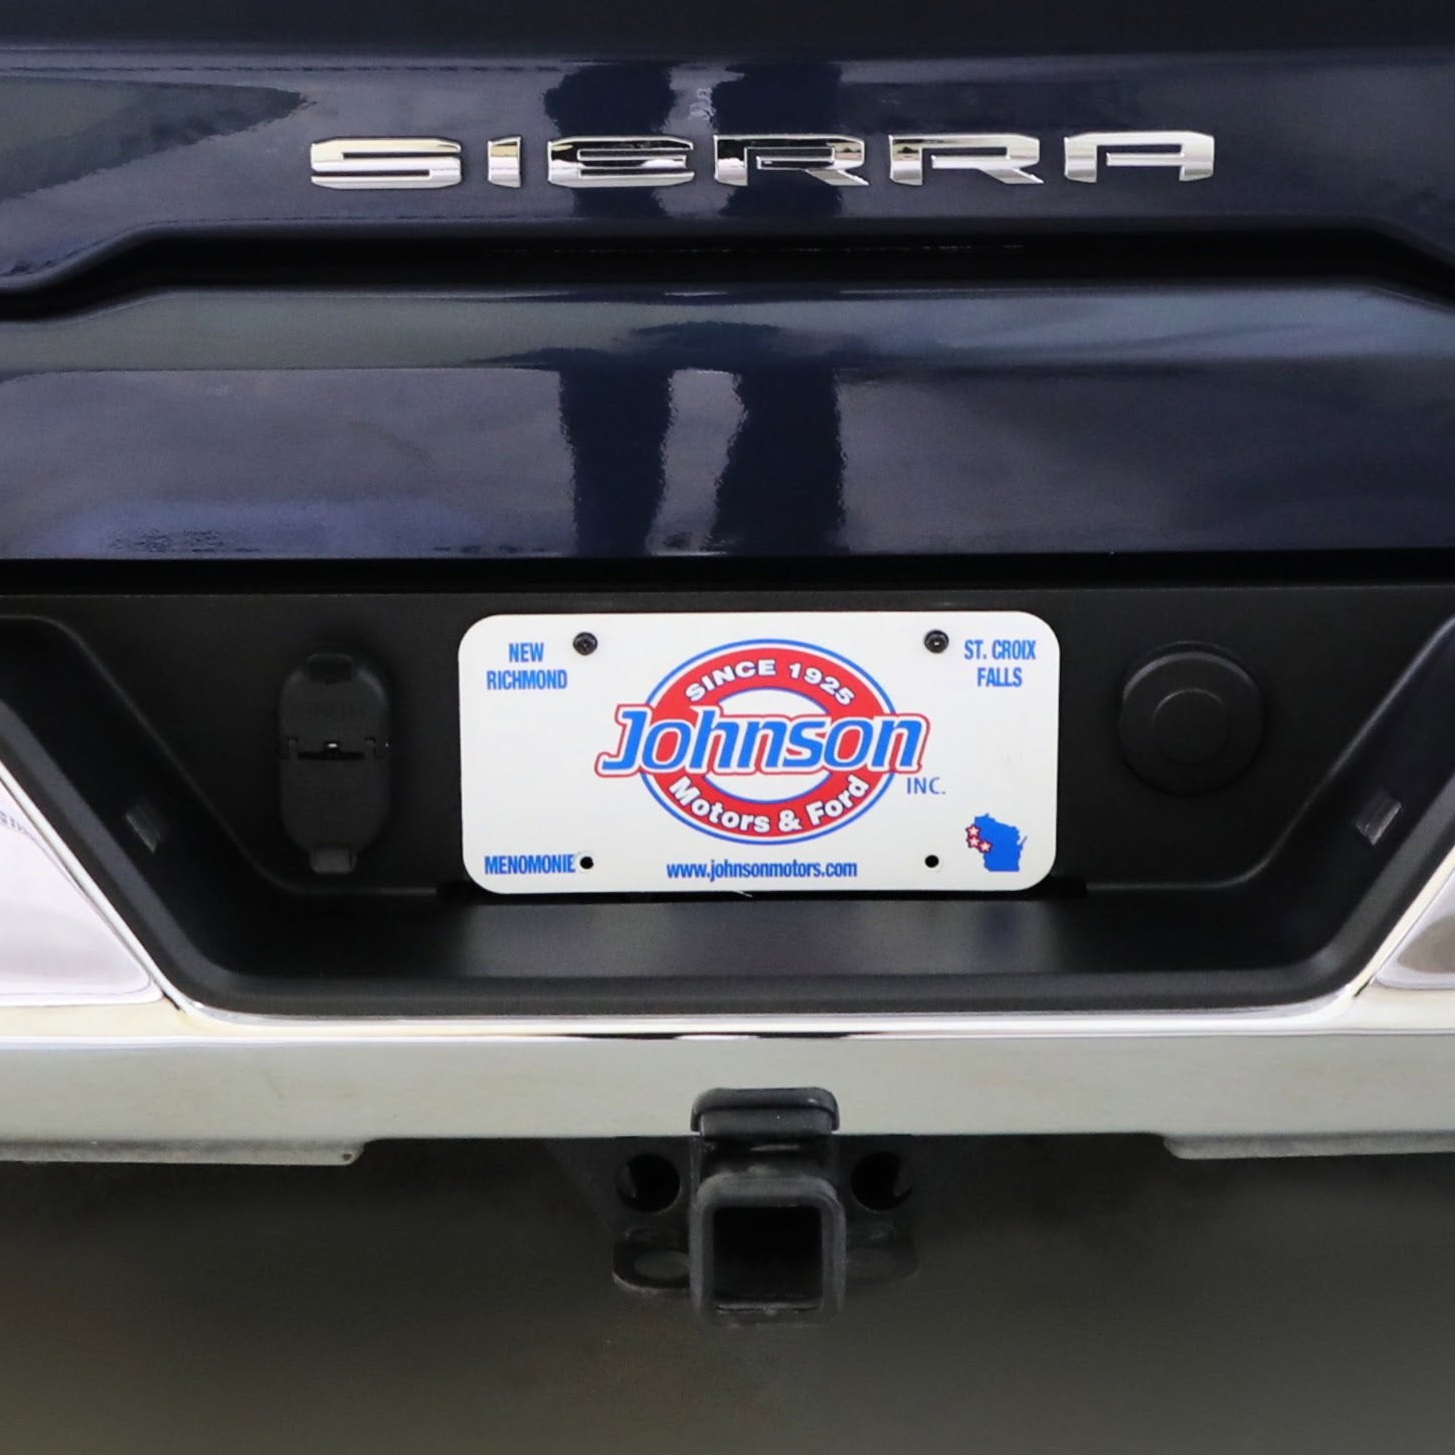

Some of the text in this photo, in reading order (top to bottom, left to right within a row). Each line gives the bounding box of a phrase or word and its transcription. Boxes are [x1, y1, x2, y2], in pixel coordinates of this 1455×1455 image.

[311, 131, 1216, 188] SIERRA
[509, 642, 544, 663] NEW
[964, 639, 1036, 660] ST. CROIX
[487, 670, 567, 690] RICHMOND
[684, 658, 855, 706] SINCE 1925
[977, 667, 1022, 687] FALLS
[599, 707, 924, 773] Johnson
[907, 777, 946, 795] INC.
[668, 774, 870, 832] Motors & Ford
[484, 854, 576, 875] MENOMONIE
[666, 859, 857, 883] www.johnsonmotors.com
